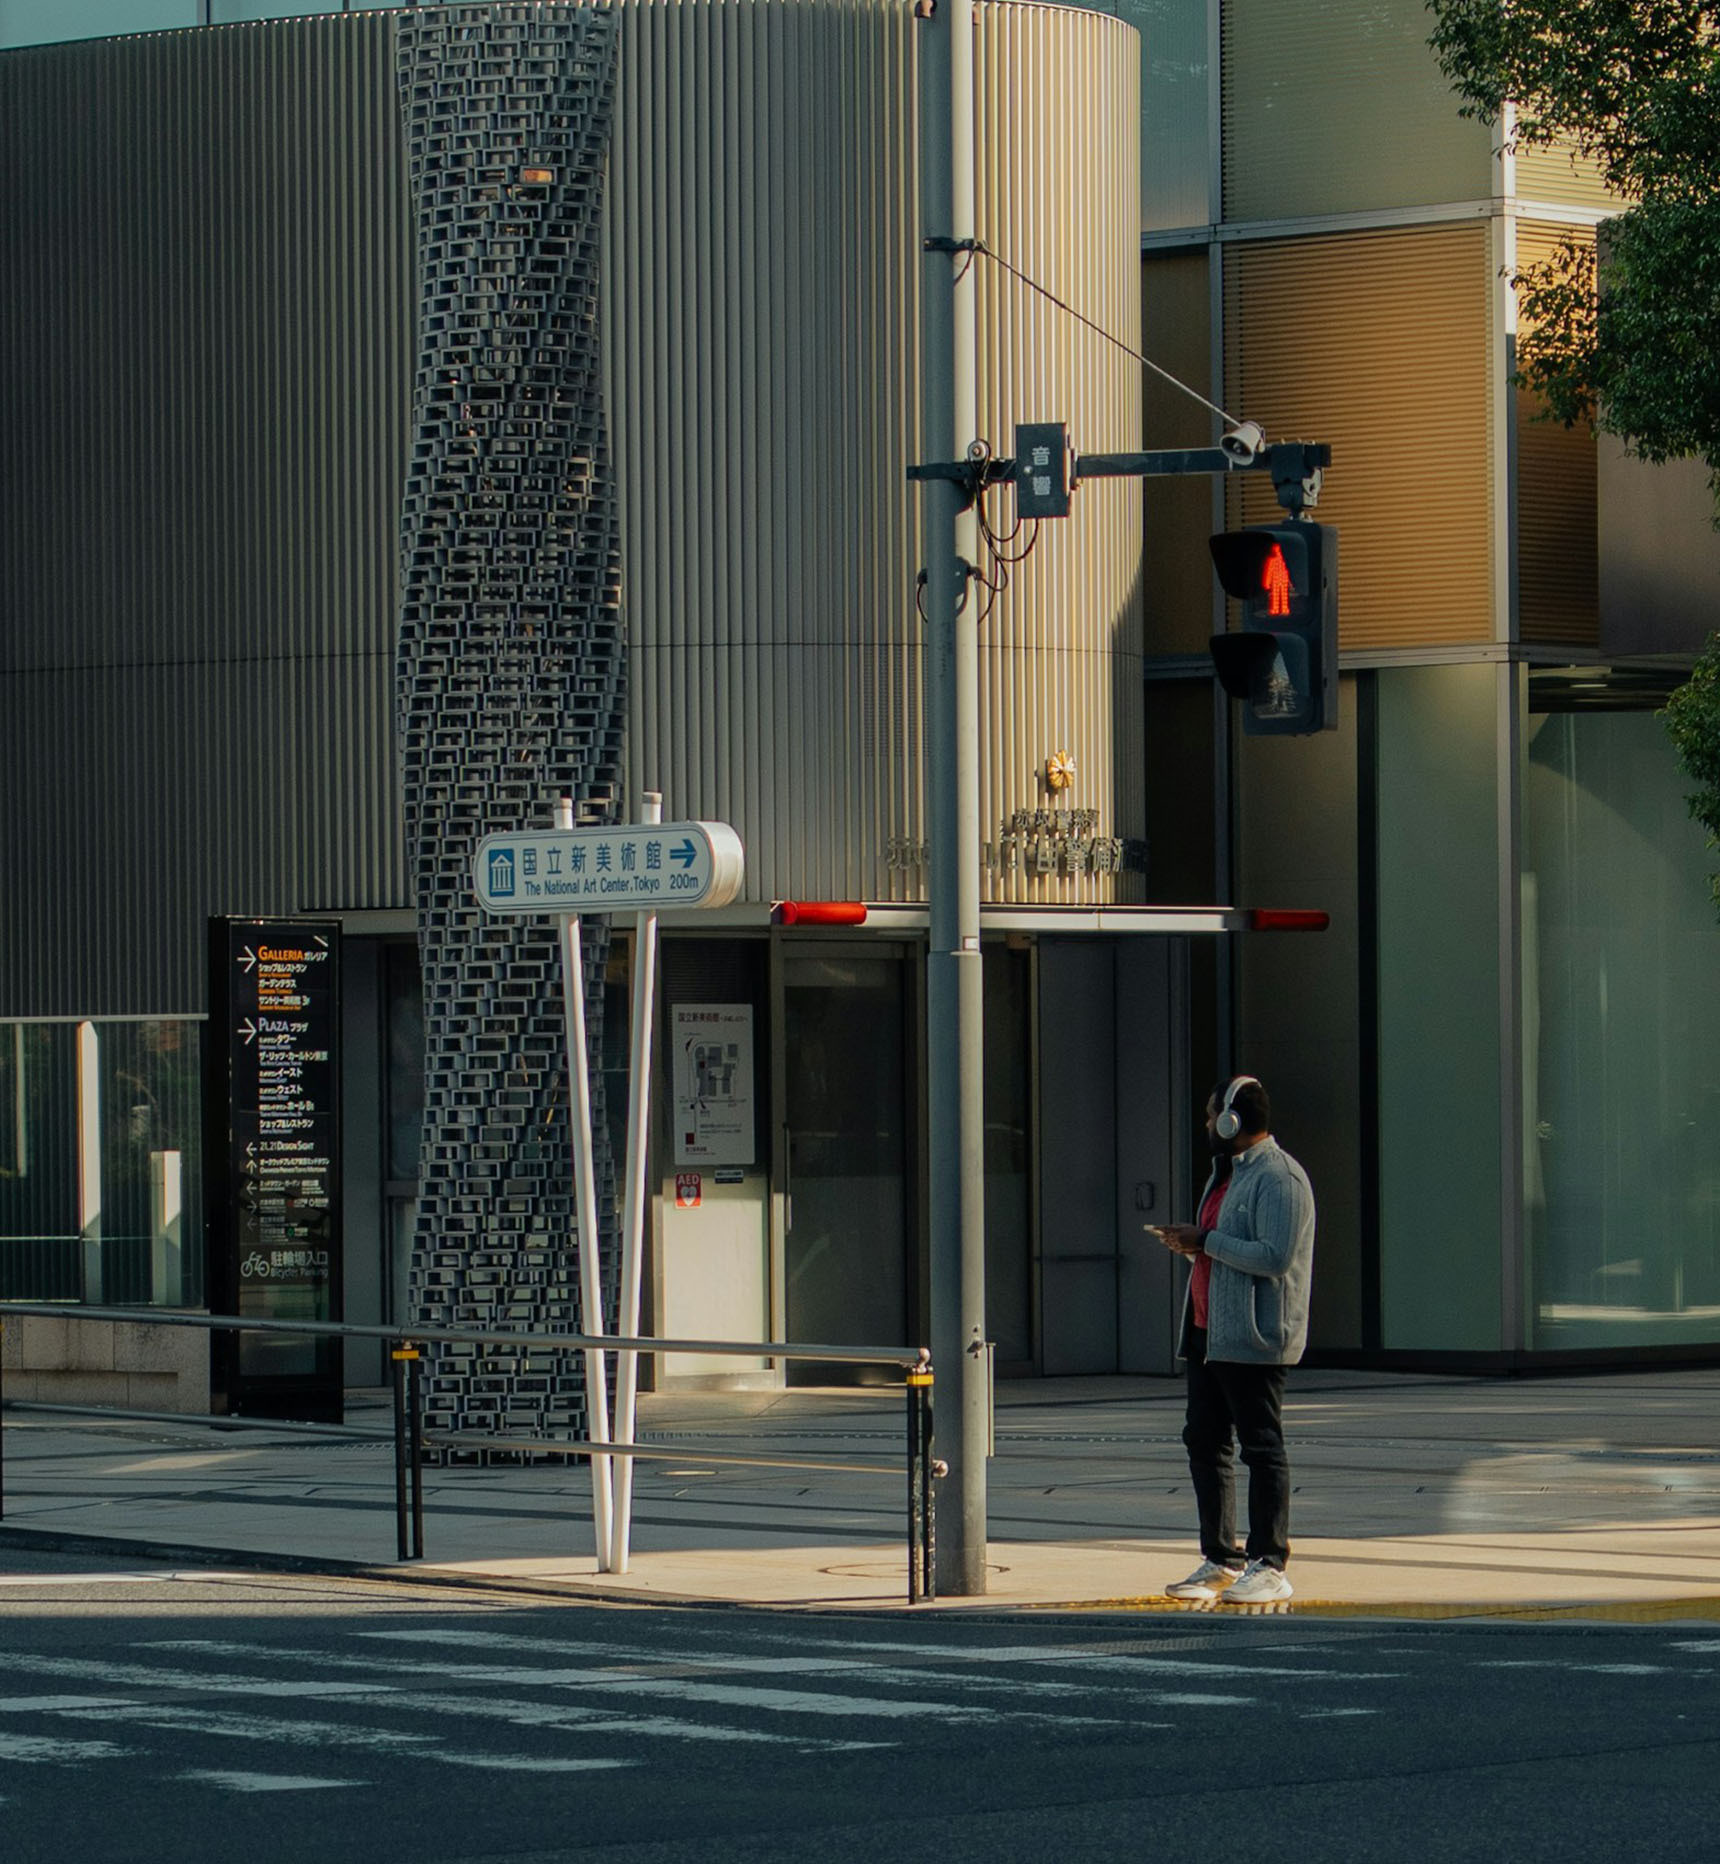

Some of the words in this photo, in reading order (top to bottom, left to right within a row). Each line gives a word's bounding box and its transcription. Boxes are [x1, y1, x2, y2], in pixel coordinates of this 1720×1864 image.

[522, 840, 662, 876] 国立新美術館
[525, 880, 541, 896] The
[544, 878, 580, 894] National
[583, 877, 597, 893] Art
[670, 873, 699, 890] 200m
[258, 945, 303, 961] GALLERIA
[258, 1017, 289, 1032] PLAZA
[677, 1174, 700, 1185] AED
